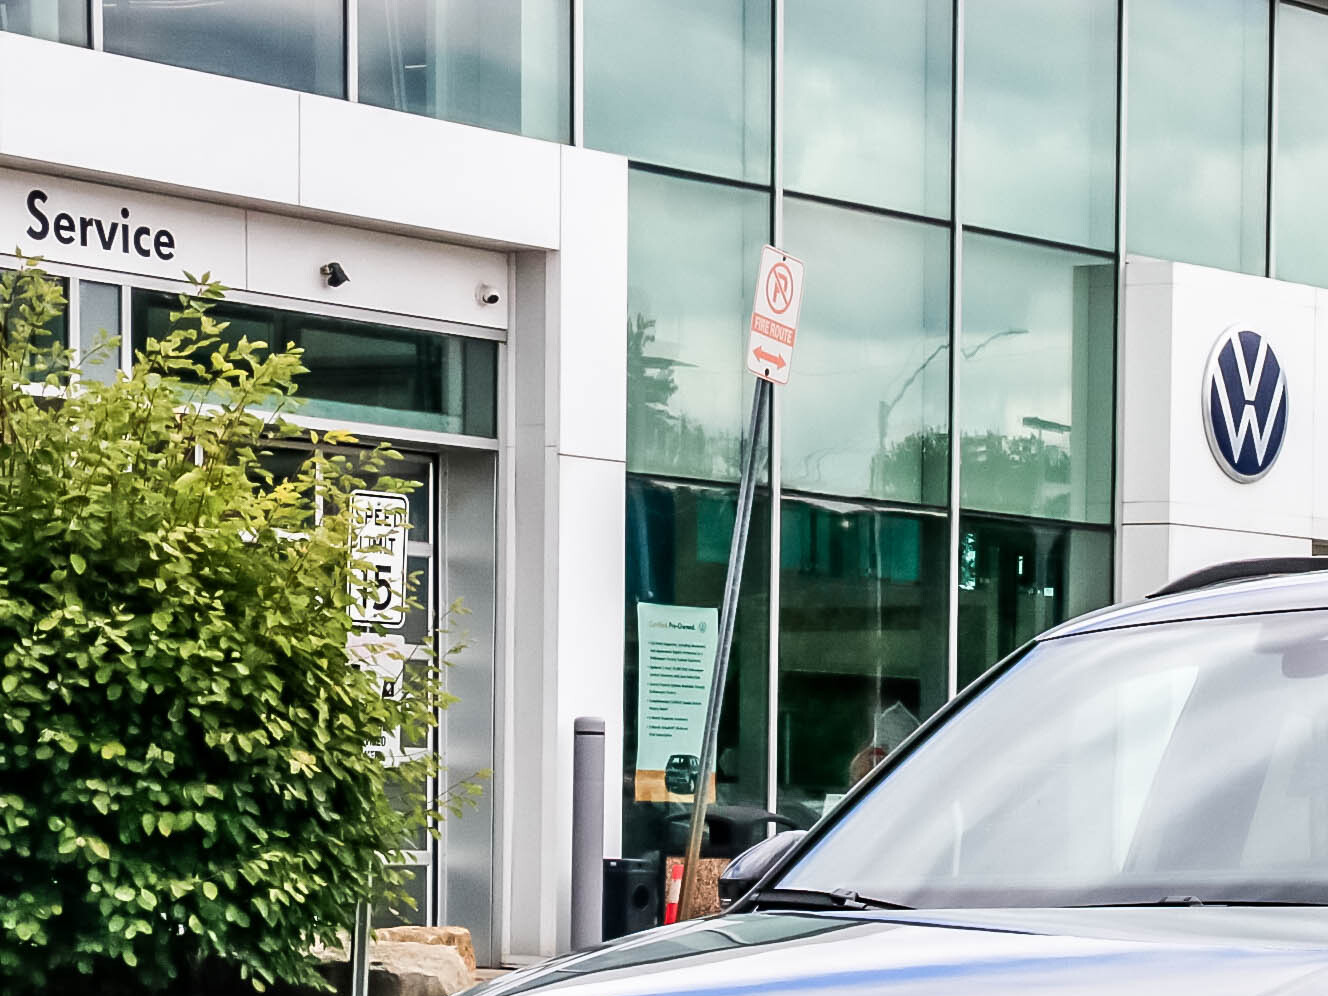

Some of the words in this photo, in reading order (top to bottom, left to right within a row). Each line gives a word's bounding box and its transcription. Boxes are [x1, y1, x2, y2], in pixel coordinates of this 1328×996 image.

[26, 189, 175, 260] Service
[754, 316, 770, 335] FIRE
[770, 322, 793, 344] ROUTE
[1207, 329, 1288, 474] VW
